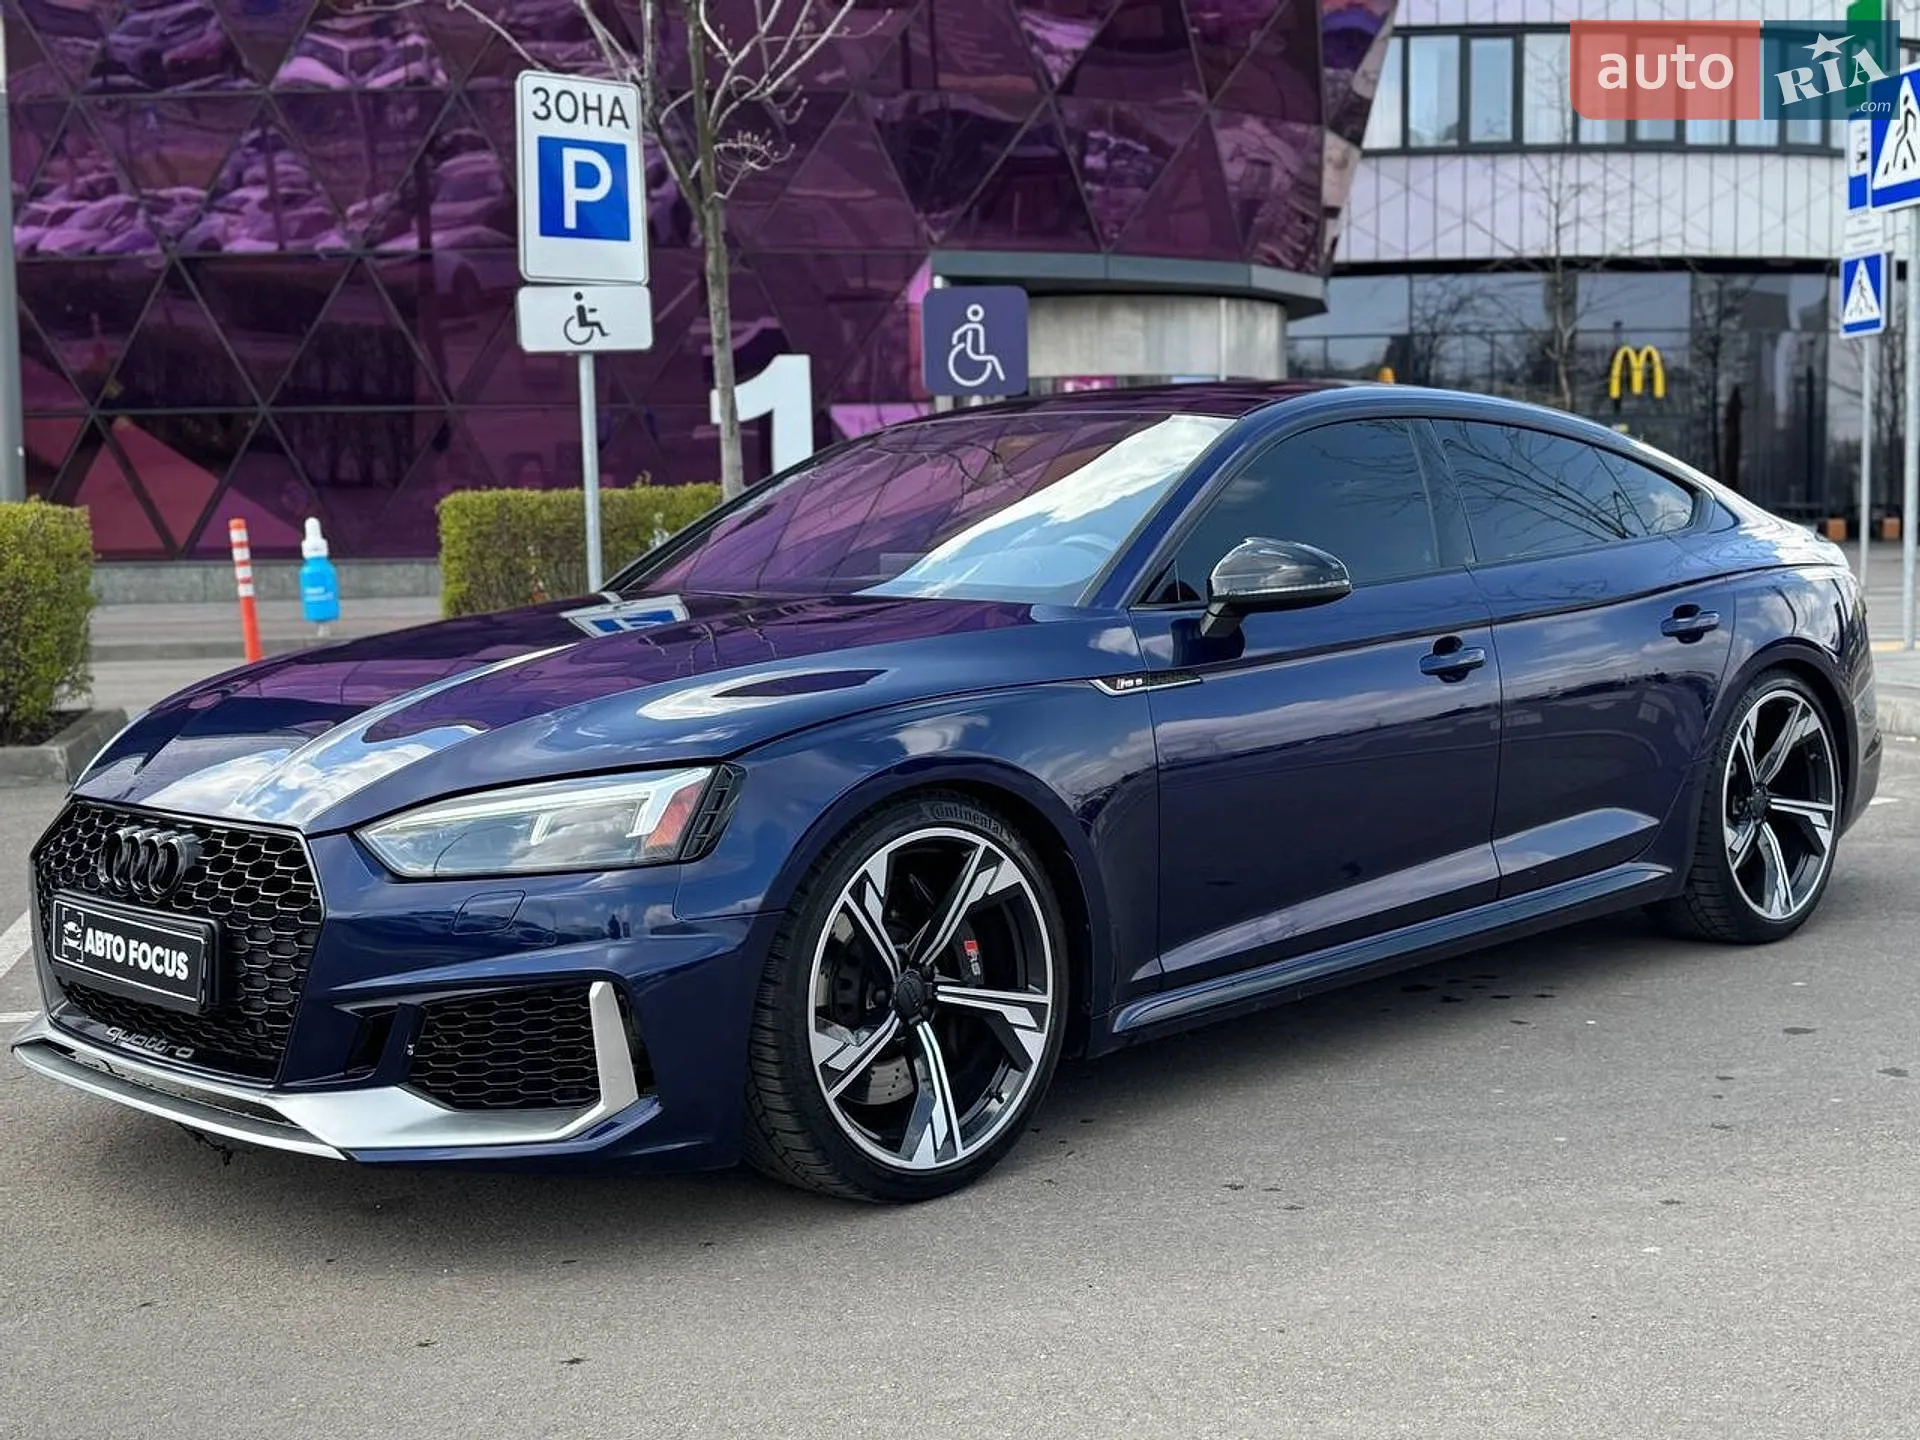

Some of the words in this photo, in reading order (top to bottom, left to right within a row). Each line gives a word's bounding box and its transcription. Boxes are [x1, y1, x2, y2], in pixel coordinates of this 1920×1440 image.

[532, 87, 630, 129] ЗОНА
[562, 147, 613, 230] P
[710, 354, 813, 474] 1
[128, 939, 189, 981] FOCUS
[105, 1026, 195, 1059] quattro
